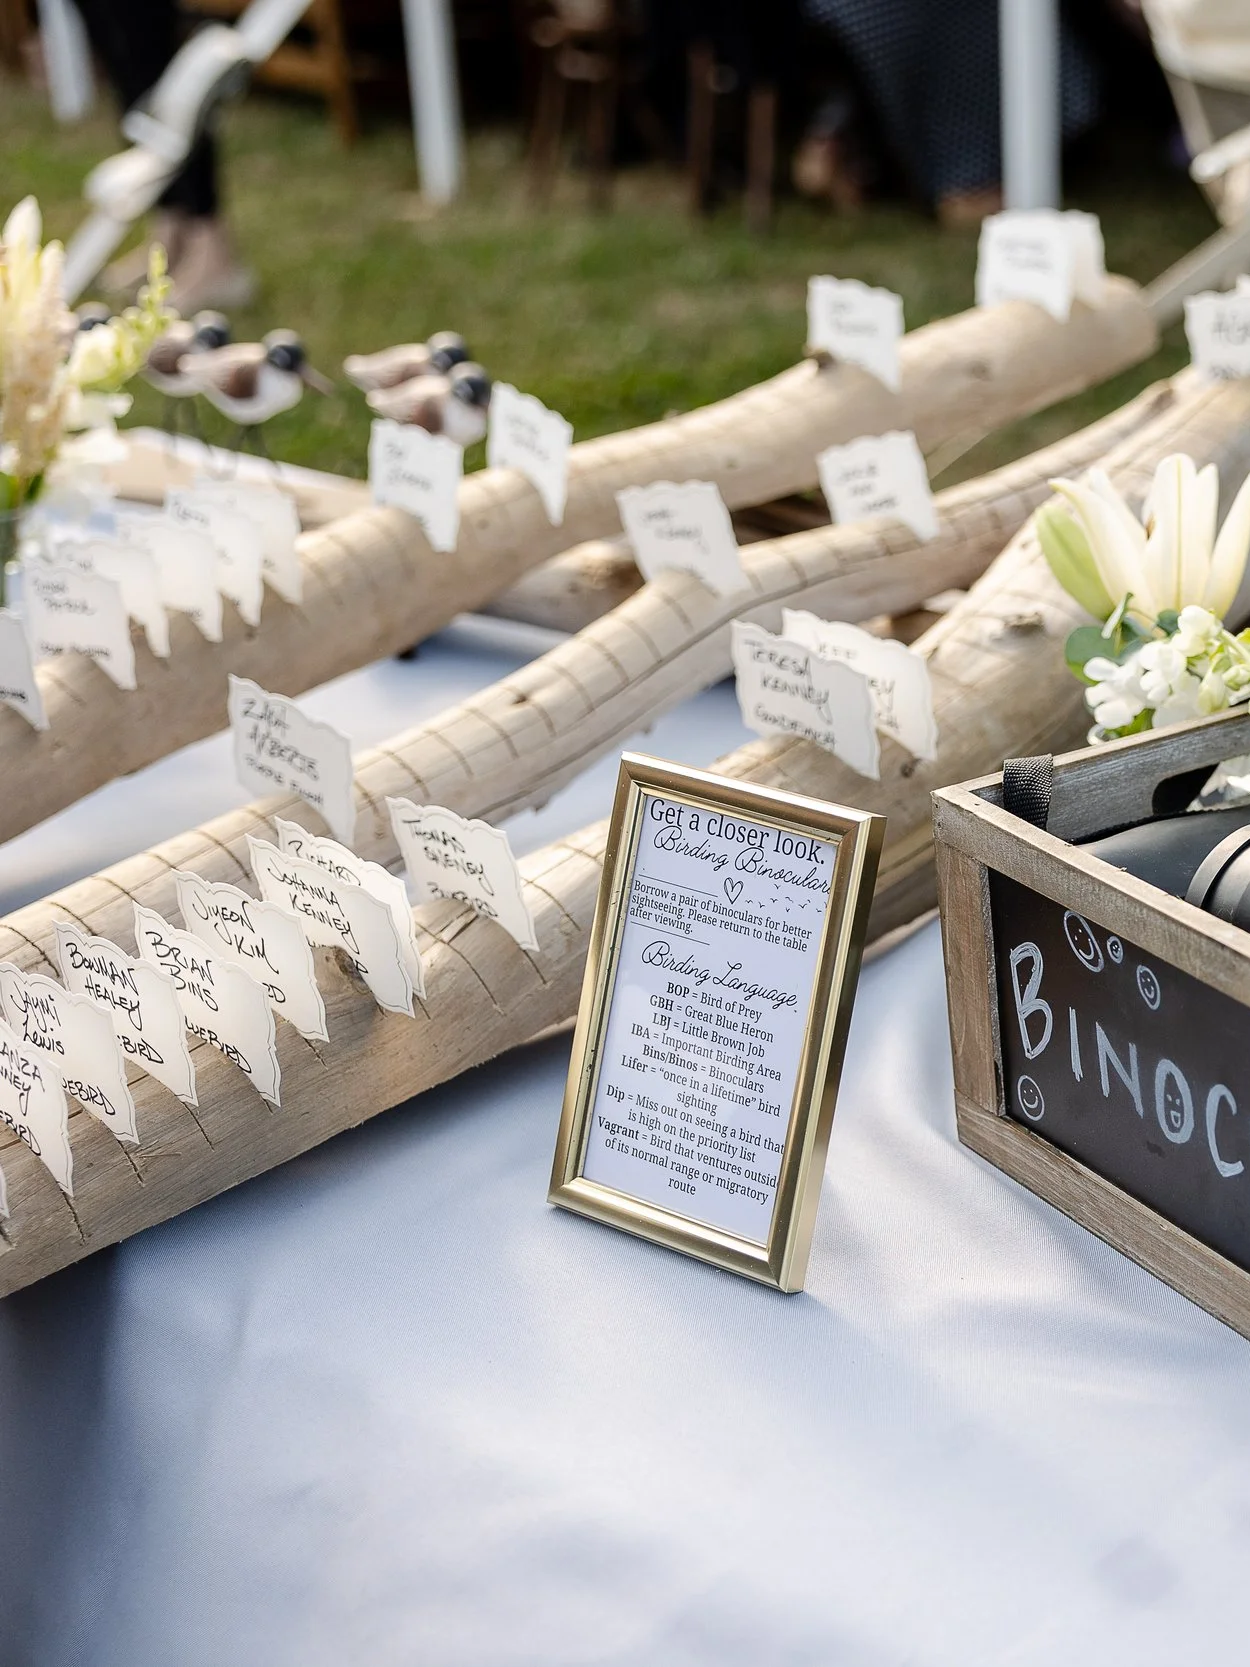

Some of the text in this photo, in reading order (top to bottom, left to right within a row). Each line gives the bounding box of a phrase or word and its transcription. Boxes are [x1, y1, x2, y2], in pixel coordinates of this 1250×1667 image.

[650, 799, 825, 865] Get a closer look.
[654, 826, 830, 895] Birding Binocular
[267, 857, 345, 917] JOHANNA
[633, 879, 812, 939] Borrow a pair of binoculars for better
[289, 892, 360, 955] KENNEY
[629, 905, 692, 934] after viewing.
[631, 892, 807, 952] sightseeing. Please return to the table
[145, 932, 215, 986] BRIAN
[234, 934, 279, 974] KIM
[641, 940, 798, 1007] Birding Language
[85, 974, 142, 1031] HEALEY
[160, 962, 219, 1011] BINS
[666, 981, 689, 998] BOP
[699, 991, 722, 1009] Bird
[724, 1000, 737, 1013] of
[737, 1002, 762, 1023] Prey
[649, 994, 674, 1012] GBH
[684, 1004, 713, 1024] Great
[714, 1013, 738, 1031] Blue
[739, 1021, 773, 1043] Heron
[651, 1012, 671, 1030] LBJ
[681, 1020, 708, 1040] Little
[710, 1030, 744, 1052] Brown
[745, 1041, 764, 1057] Job
[630, 1022, 650, 1039] IBA
[661, 1032, 713, 1059] Important
[715, 1049, 755, 1075] Birding
[755, 1063, 781, 1081] Area
[642, 1043, 698, 1071] Bins/Binos
[708, 1065, 764, 1093] Binoculars
[620, 1054, 648, 1072] Lifer
[689, 1075, 699, 1090] in
[701, 1083, 708, 1093] a
[757, 1097, 780, 1117] bird
[676, 1091, 717, 1116] sighting
[606, 1084, 624, 1103] Dip
[635, 1093, 658, 1111] Miss
[660, 1104, 678, 1118] out
[679, 1111, 692, 1123] on
[694, 1116, 728, 1137] seeing
[729, 1128, 736, 1138] a
[738, 1127, 761, 1146] bird
[763, 1137, 784, 1154] that
[627, 1108, 756, 1163] is high on the priority list
[597, 1115, 639, 1140] Vagrant
[649, 1133, 672, 1151] Bird
[673, 1142, 694, 1159] that
[696, 1151, 742, 1175] ventures
[744, 1169, 778, 1188] outsid
[604, 1137, 768, 1205] of its normal range or migratory
[667, 1177, 696, 1195] route
